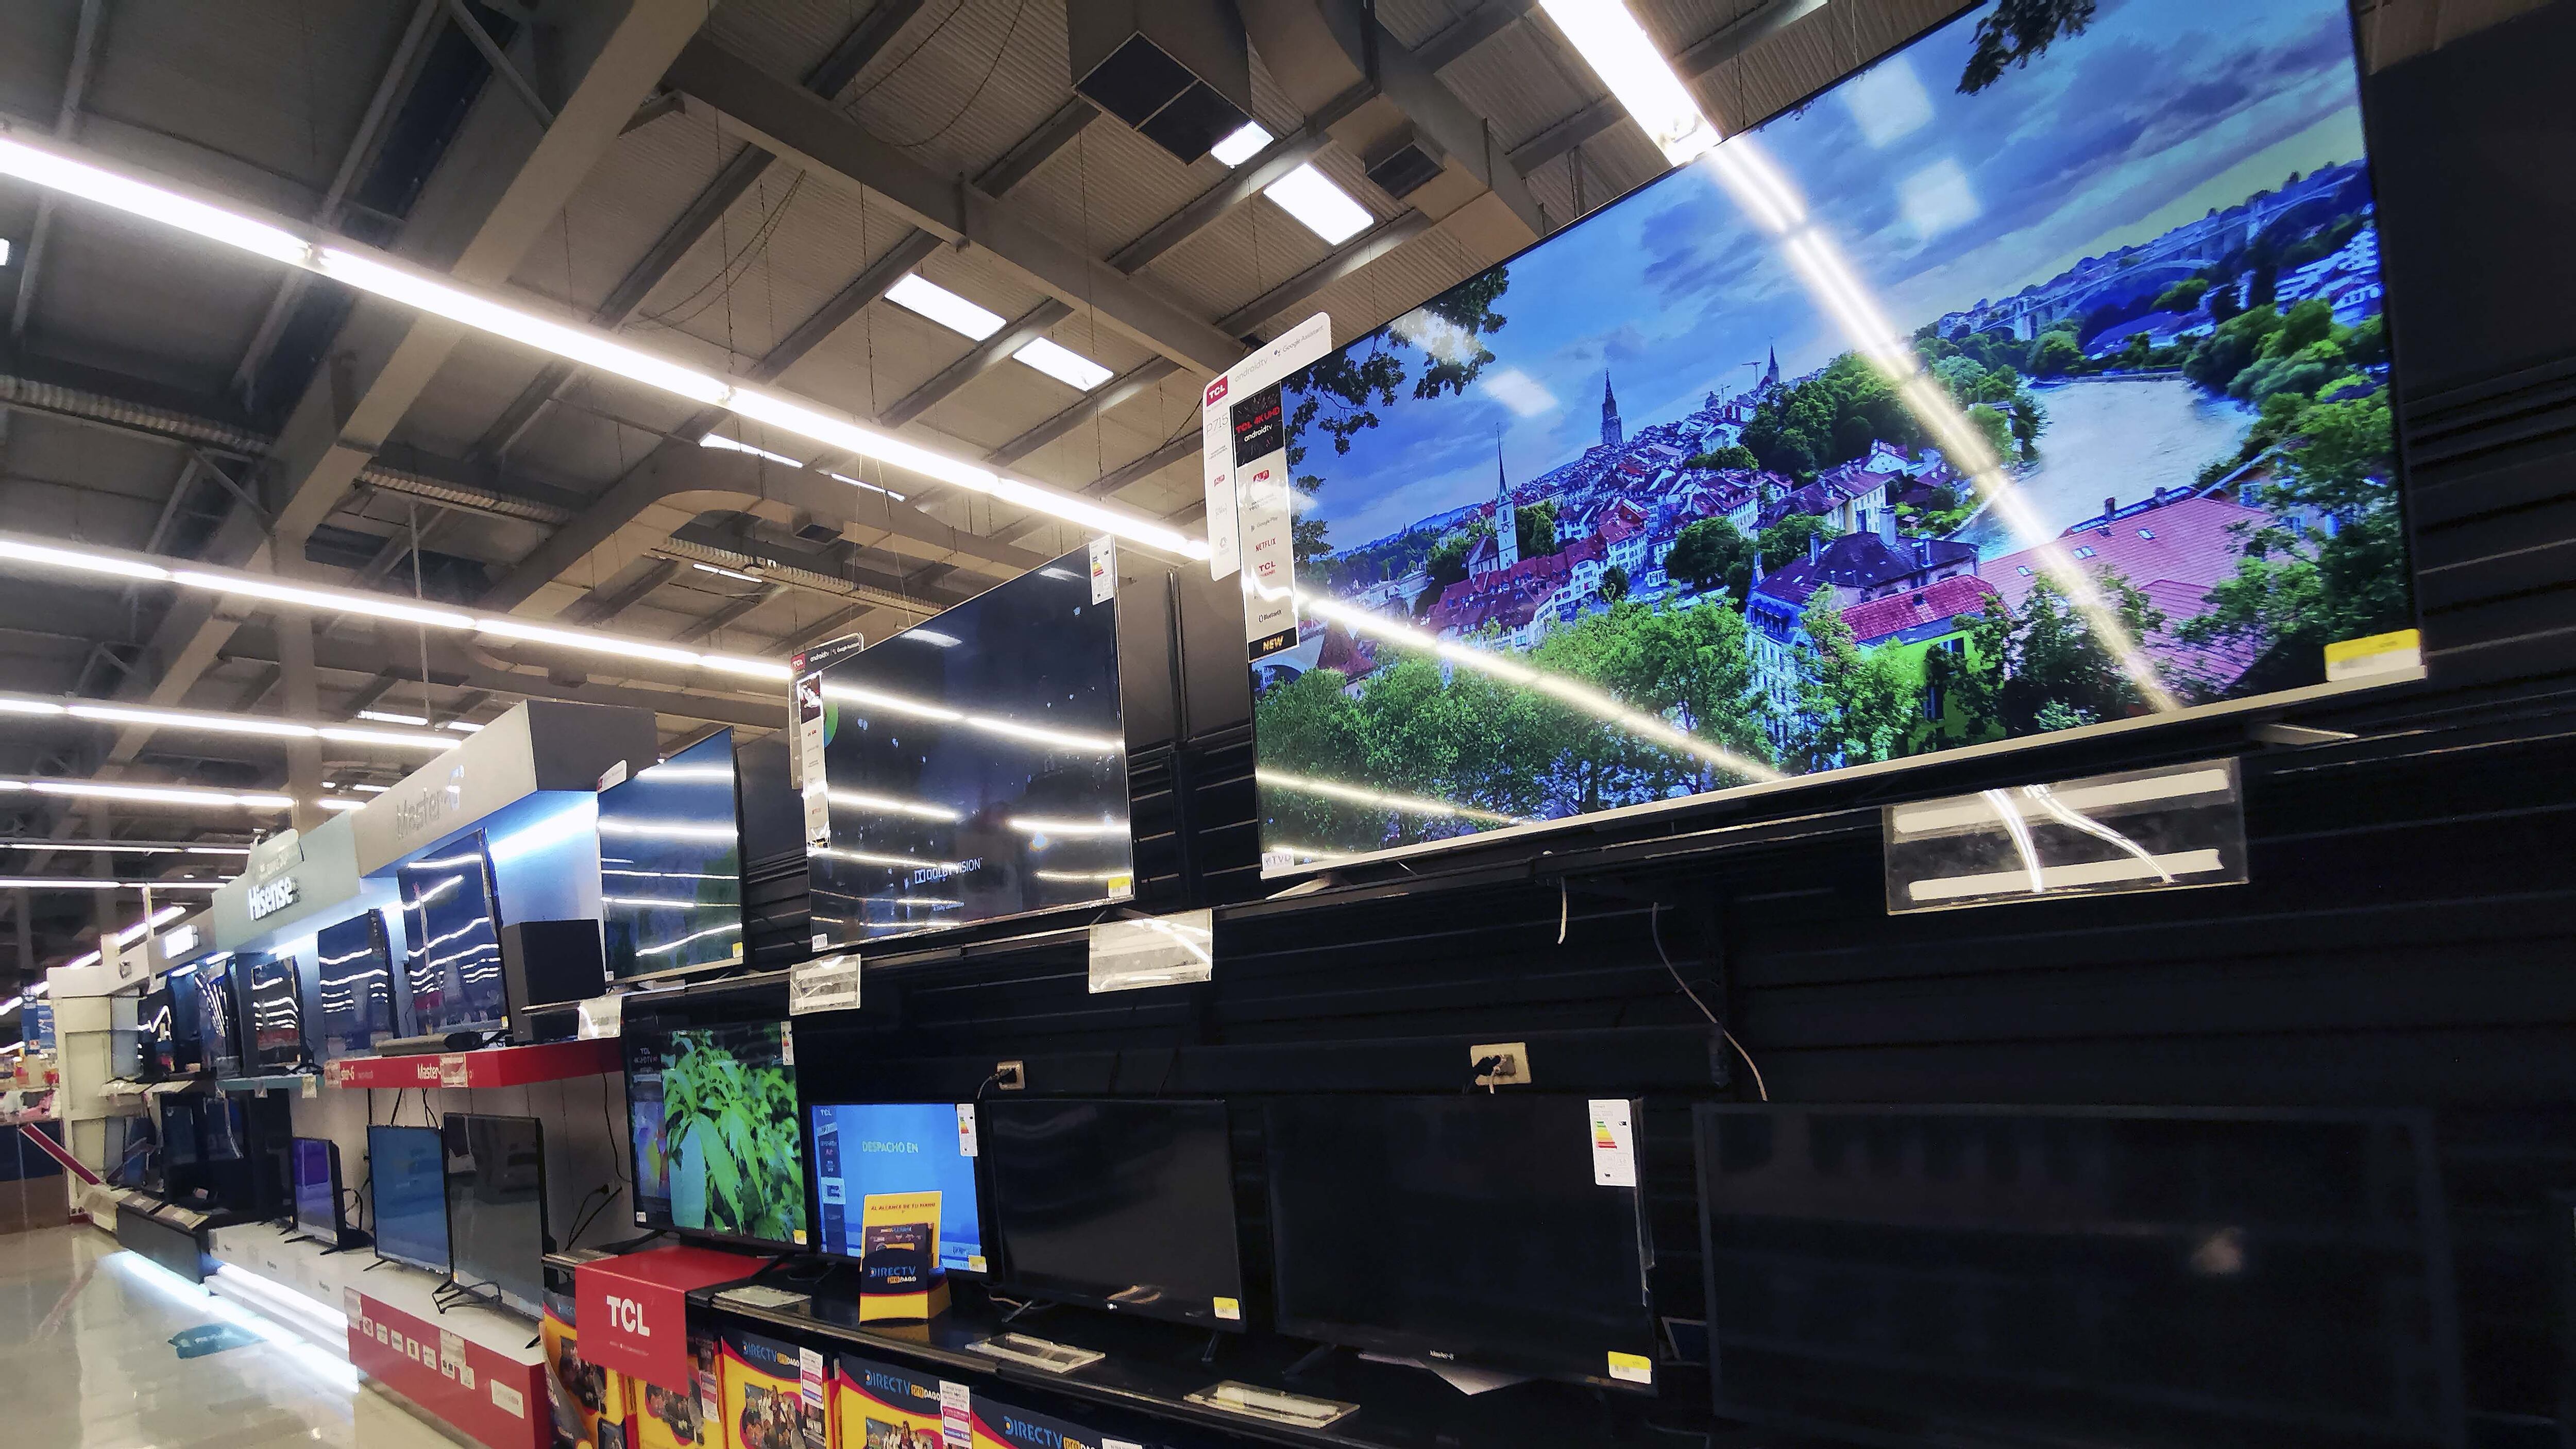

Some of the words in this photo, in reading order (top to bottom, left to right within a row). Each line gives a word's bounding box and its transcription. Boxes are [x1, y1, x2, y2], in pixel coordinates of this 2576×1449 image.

[1282, 338, 1300, 353] Google
[1209, 384, 1225, 399] TCL
[1206, 413, 1229, 437] P715
[1236, 421, 1252, 434] TCL
[1264, 406, 1280, 419] UHD
[1244, 423, 1273, 442] androidtv
[1256, 537, 1276, 552] NETFLIX
[1259, 560, 1276, 572] TCL
[1263, 635, 1283, 652] NEW
[792, 659, 803, 668] TCL
[954, 858, 980, 875] VISION
[248, 876, 294, 920] Hisense
[417, 1063, 441, 1080] Master-
[862, 1141, 905, 1153] DESPACHO
[907, 1142, 919, 1153] EN
[870, 1265, 916, 1277] DIRECTV
[606, 1295, 650, 1337] TCL
[742, 1340, 777, 1362] DIRECTV
[865, 1369, 911, 1396] DIRECTV
[1004, 1416, 1062, 1449] DIRECTV
